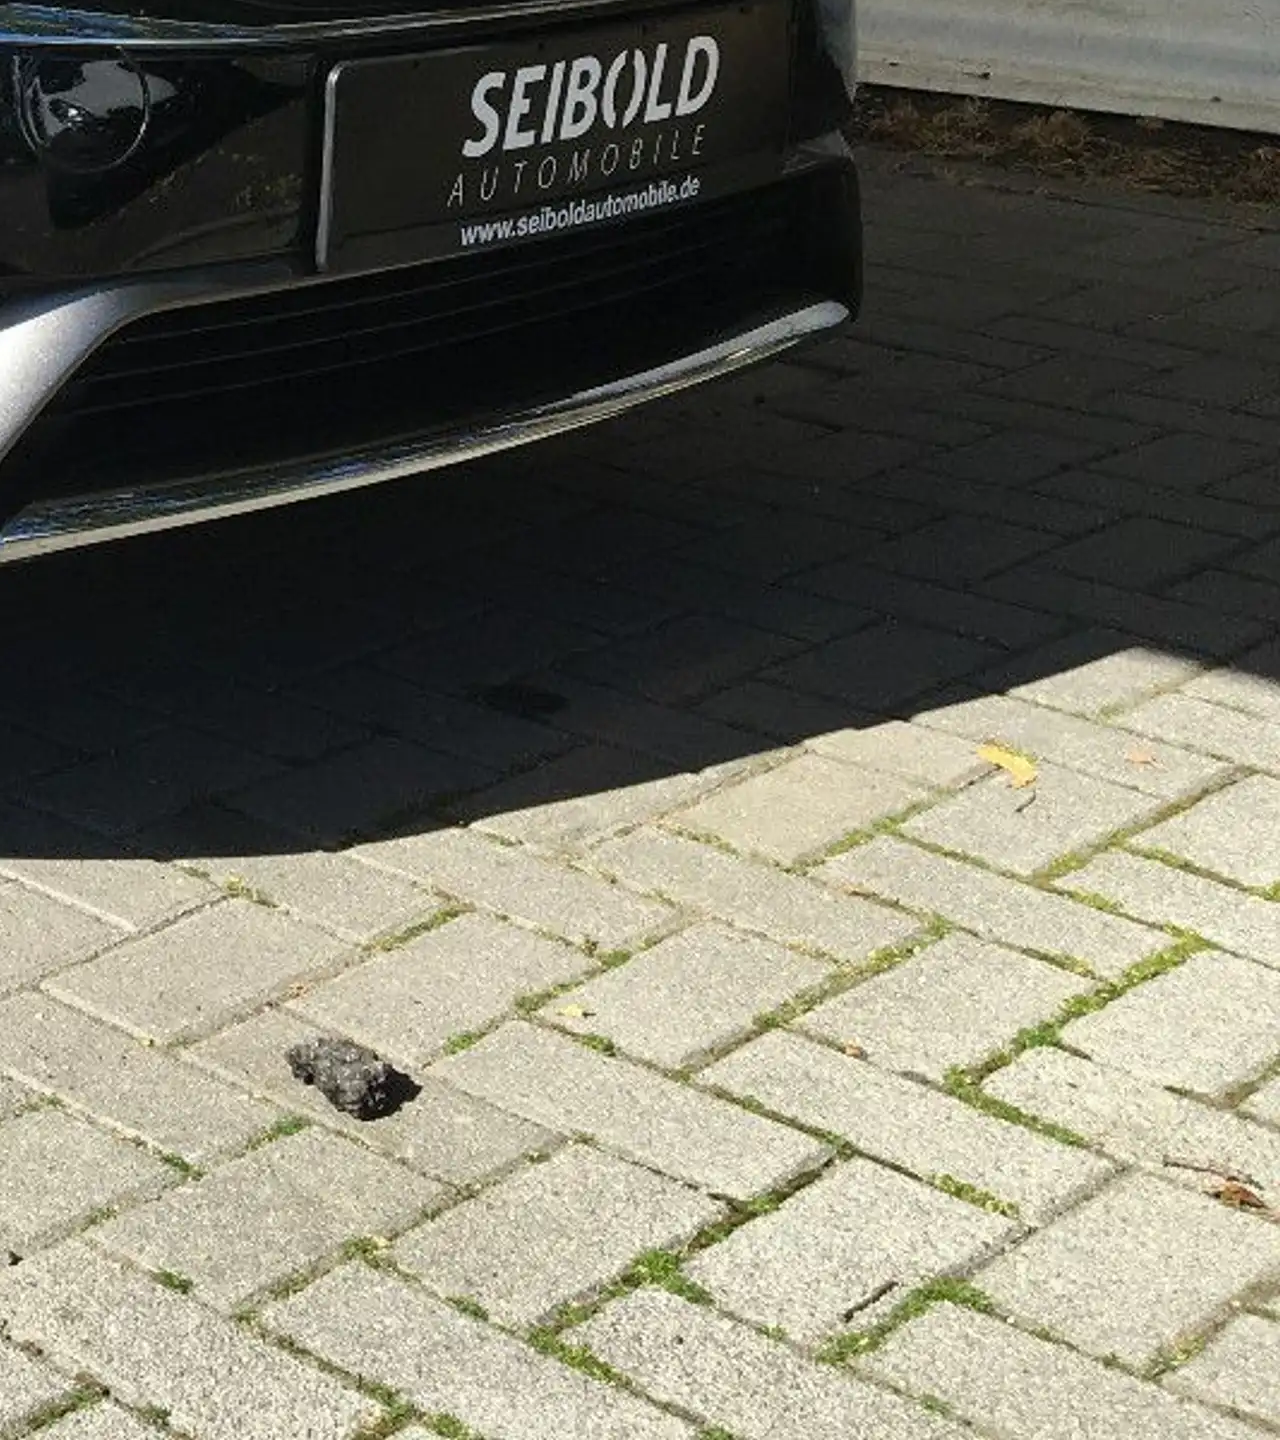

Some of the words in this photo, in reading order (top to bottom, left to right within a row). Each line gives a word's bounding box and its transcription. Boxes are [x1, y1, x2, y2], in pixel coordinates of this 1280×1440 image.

[462, 35, 720, 158] SEIBOLD
[446, 124, 706, 208] AUTOMOBILE
[460, 174, 701, 246] www.seiboldautomobile.de
